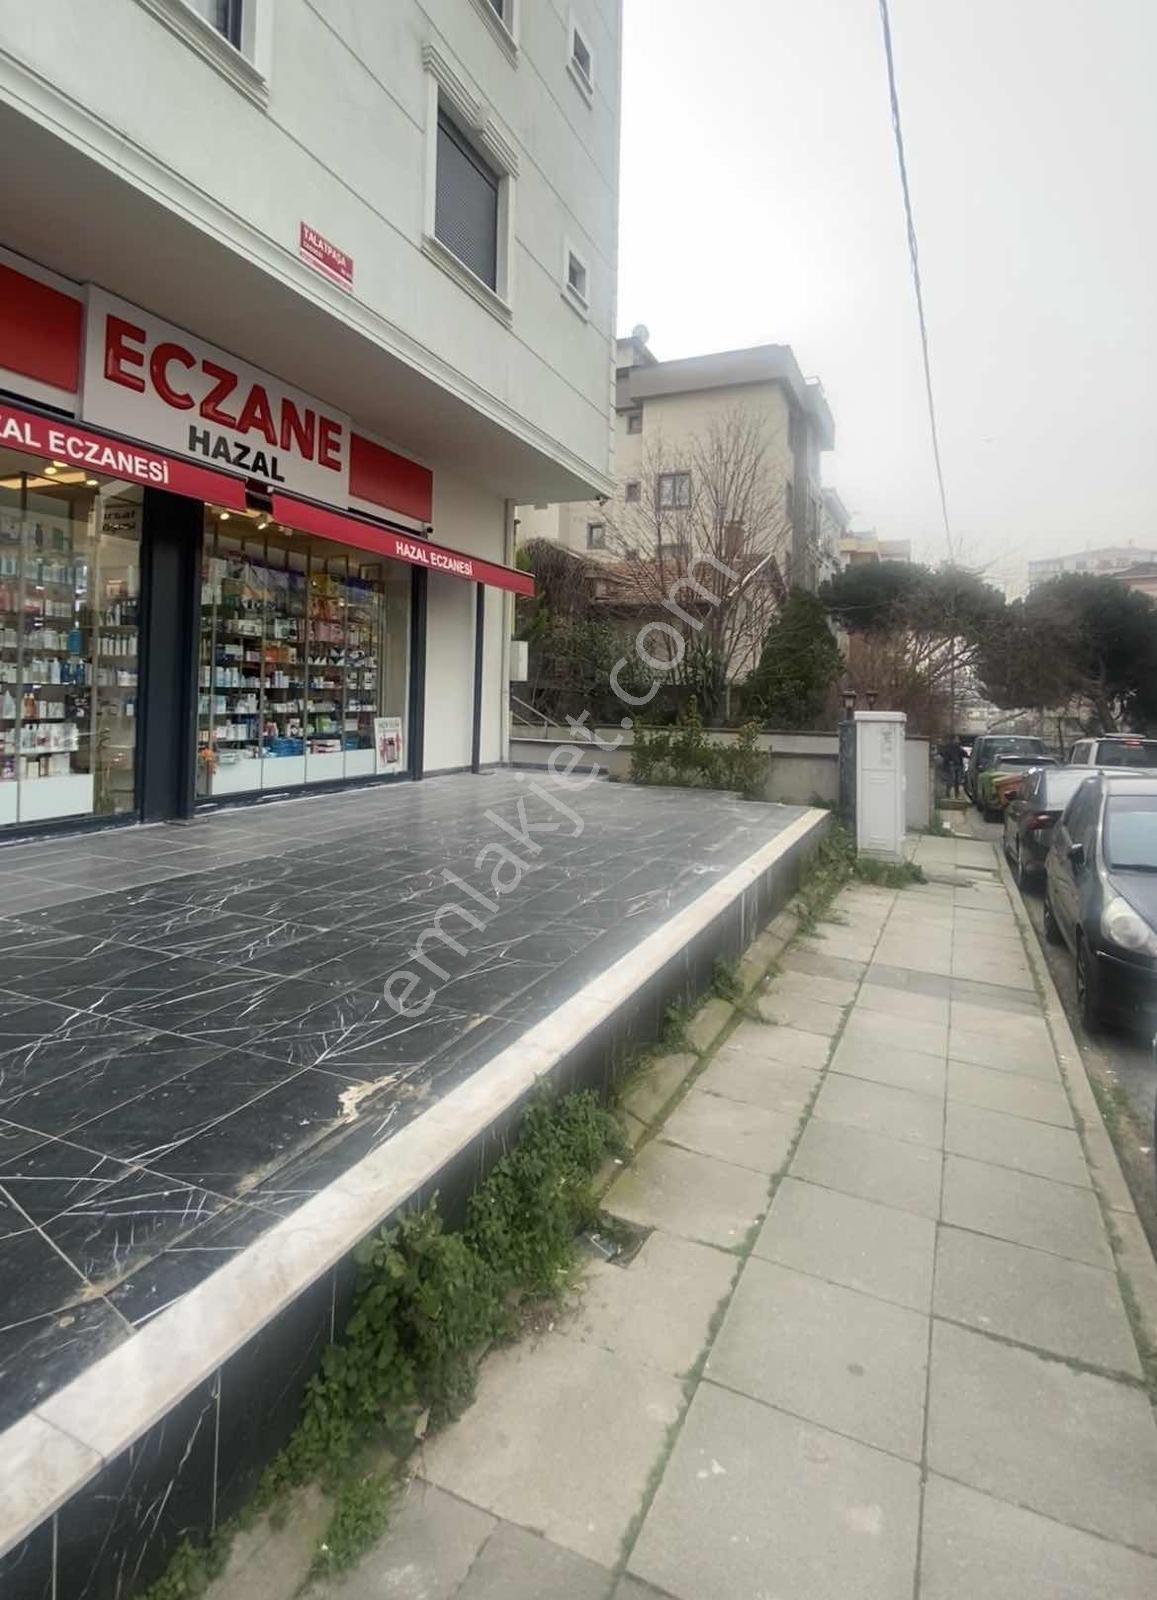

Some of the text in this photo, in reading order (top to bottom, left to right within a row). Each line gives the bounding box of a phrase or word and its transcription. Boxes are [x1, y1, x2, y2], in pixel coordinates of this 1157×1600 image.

[104, 314, 342, 471] ECZANE
[48, 430, 169, 484] ECZANESİ
[188, 425, 286, 483] HAZAL
[395, 540, 473, 577] HAZAL ECZANESİ
